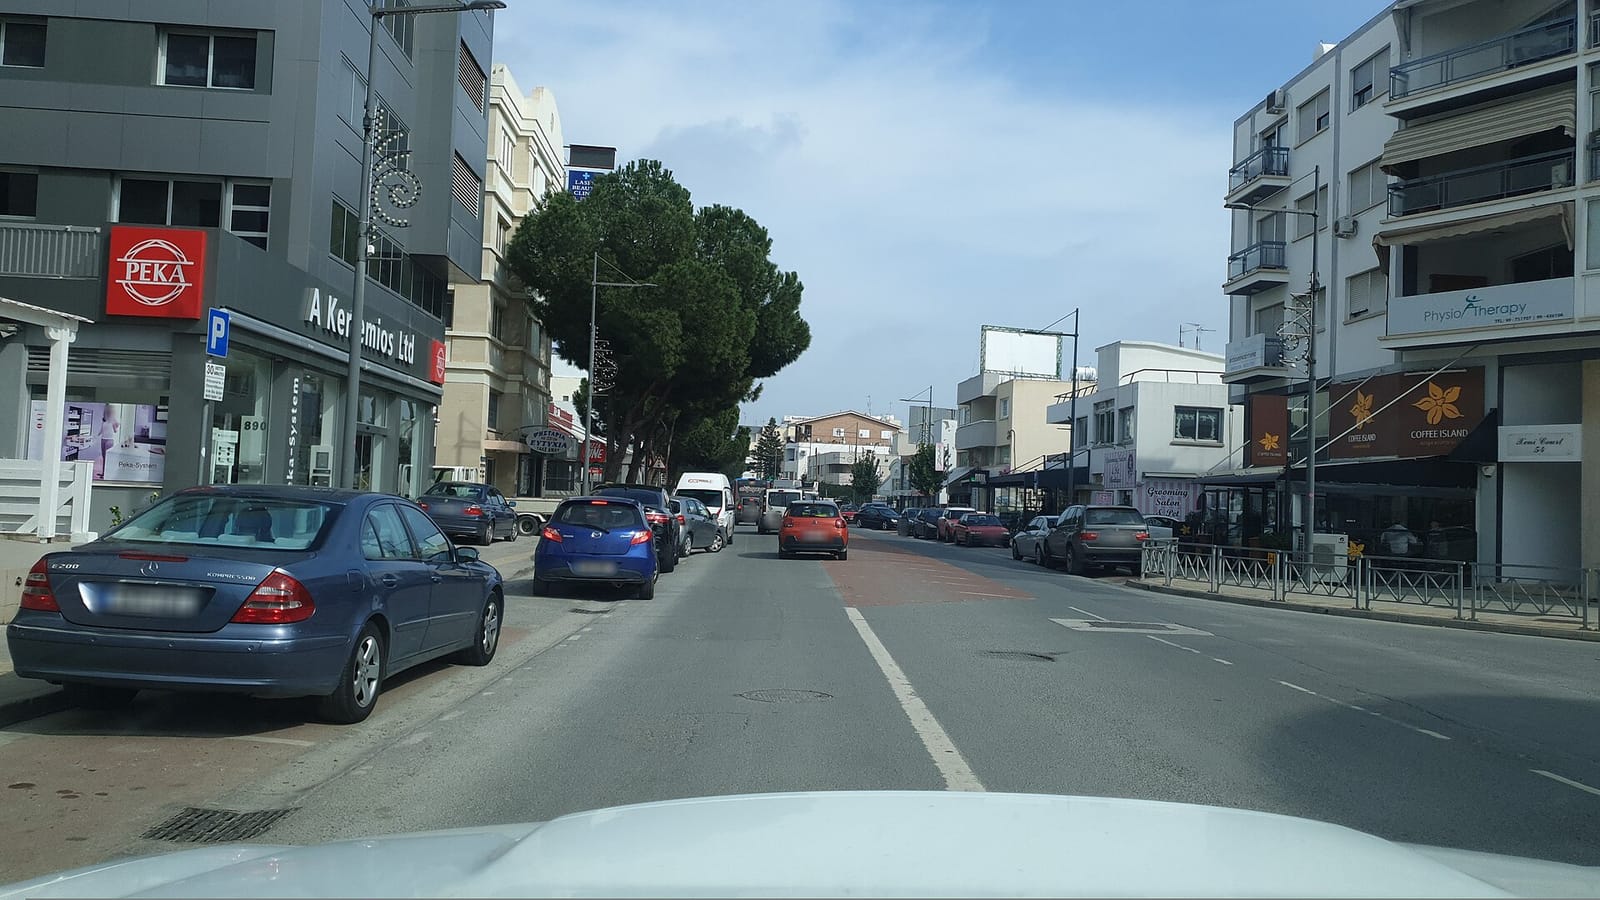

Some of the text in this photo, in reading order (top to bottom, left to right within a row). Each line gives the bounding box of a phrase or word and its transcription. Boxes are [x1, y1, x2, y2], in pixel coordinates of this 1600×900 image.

[125, 261, 186, 283] PEKA
[309, 288, 320, 325] A
[399, 331, 415, 365] Ltd
[211, 316, 225, 349] P
[244, 421, 266, 431] 890
[1410, 429, 1468, 439] COFFEE ISLAND
[1147, 487, 1189, 498] Grooming
[1155, 498, 1181, 506] Salon
